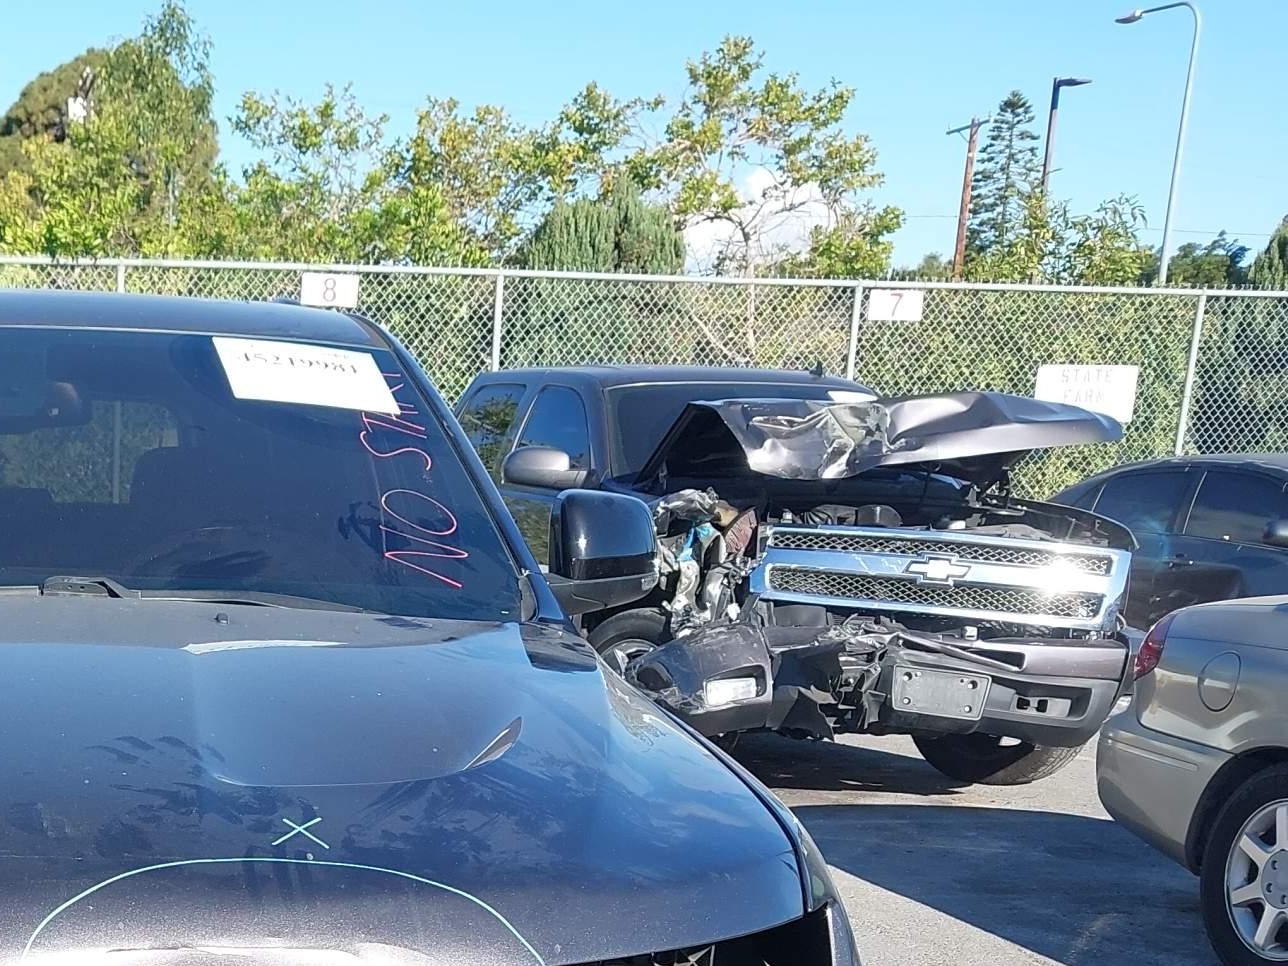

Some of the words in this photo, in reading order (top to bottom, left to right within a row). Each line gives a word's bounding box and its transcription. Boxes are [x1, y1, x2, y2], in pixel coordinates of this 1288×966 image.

[323, 278, 336, 302] 8
[890, 293, 904, 317] 7
[1061, 368, 1113, 383] STATE
[379, 489, 469, 588] NO
